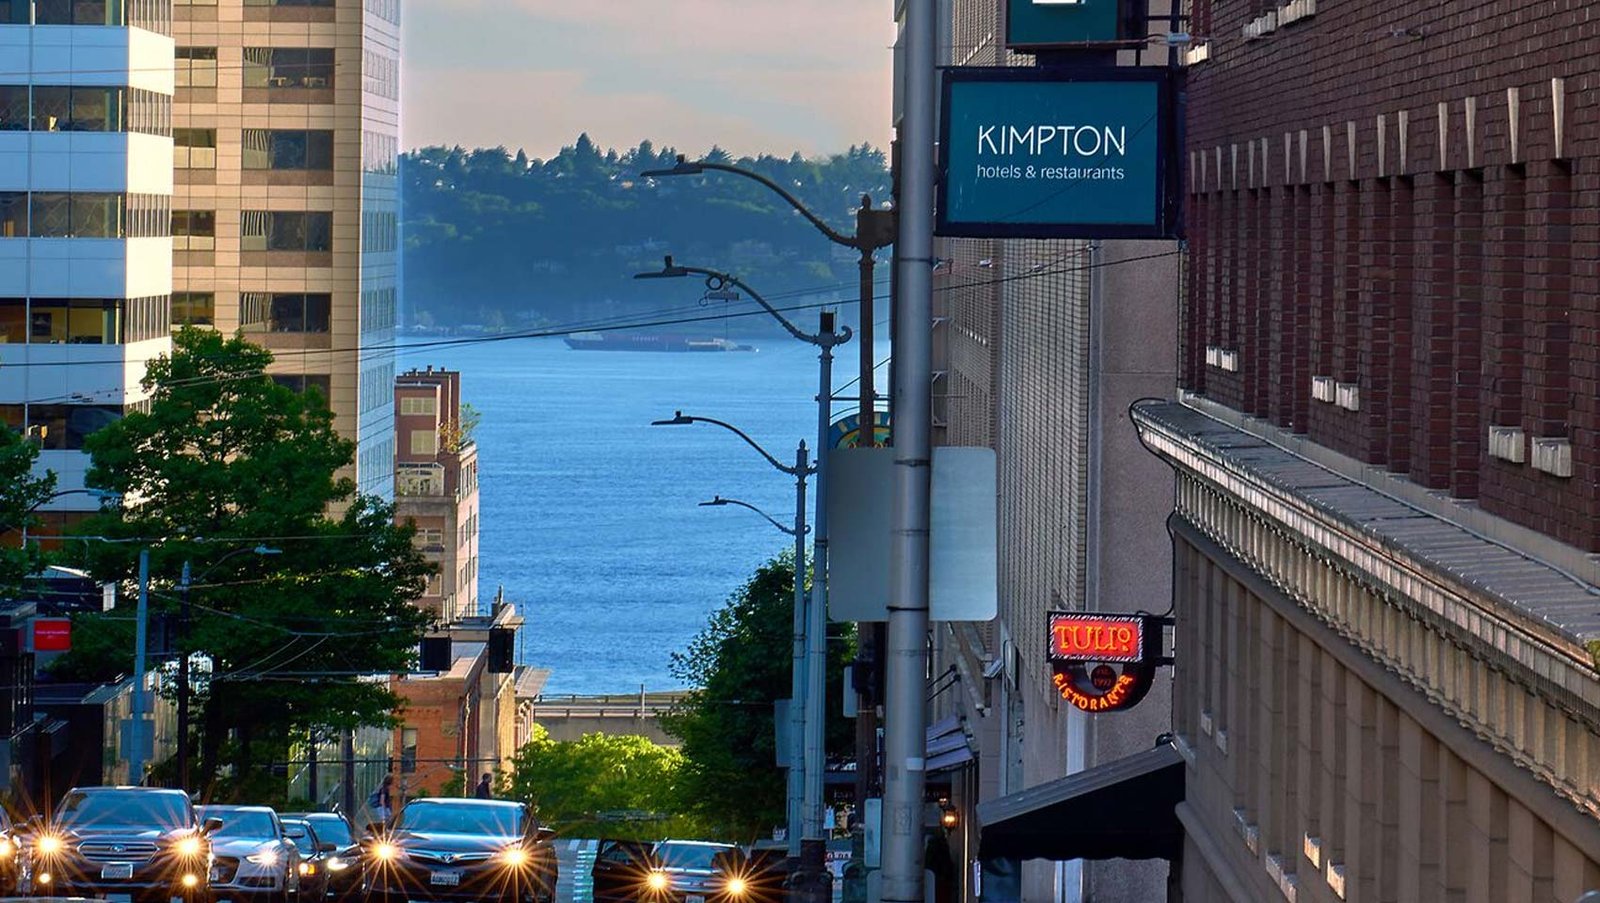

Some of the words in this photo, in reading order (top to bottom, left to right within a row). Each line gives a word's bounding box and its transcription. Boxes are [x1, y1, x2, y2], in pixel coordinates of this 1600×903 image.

[978, 125, 1125, 156] KIMPTON
[977, 165, 1021, 178] hotels
[1025, 165, 1037, 179] &
[1041, 166, 1125, 179] restaurants
[1053, 673, 1133, 710] RISTORANTE
